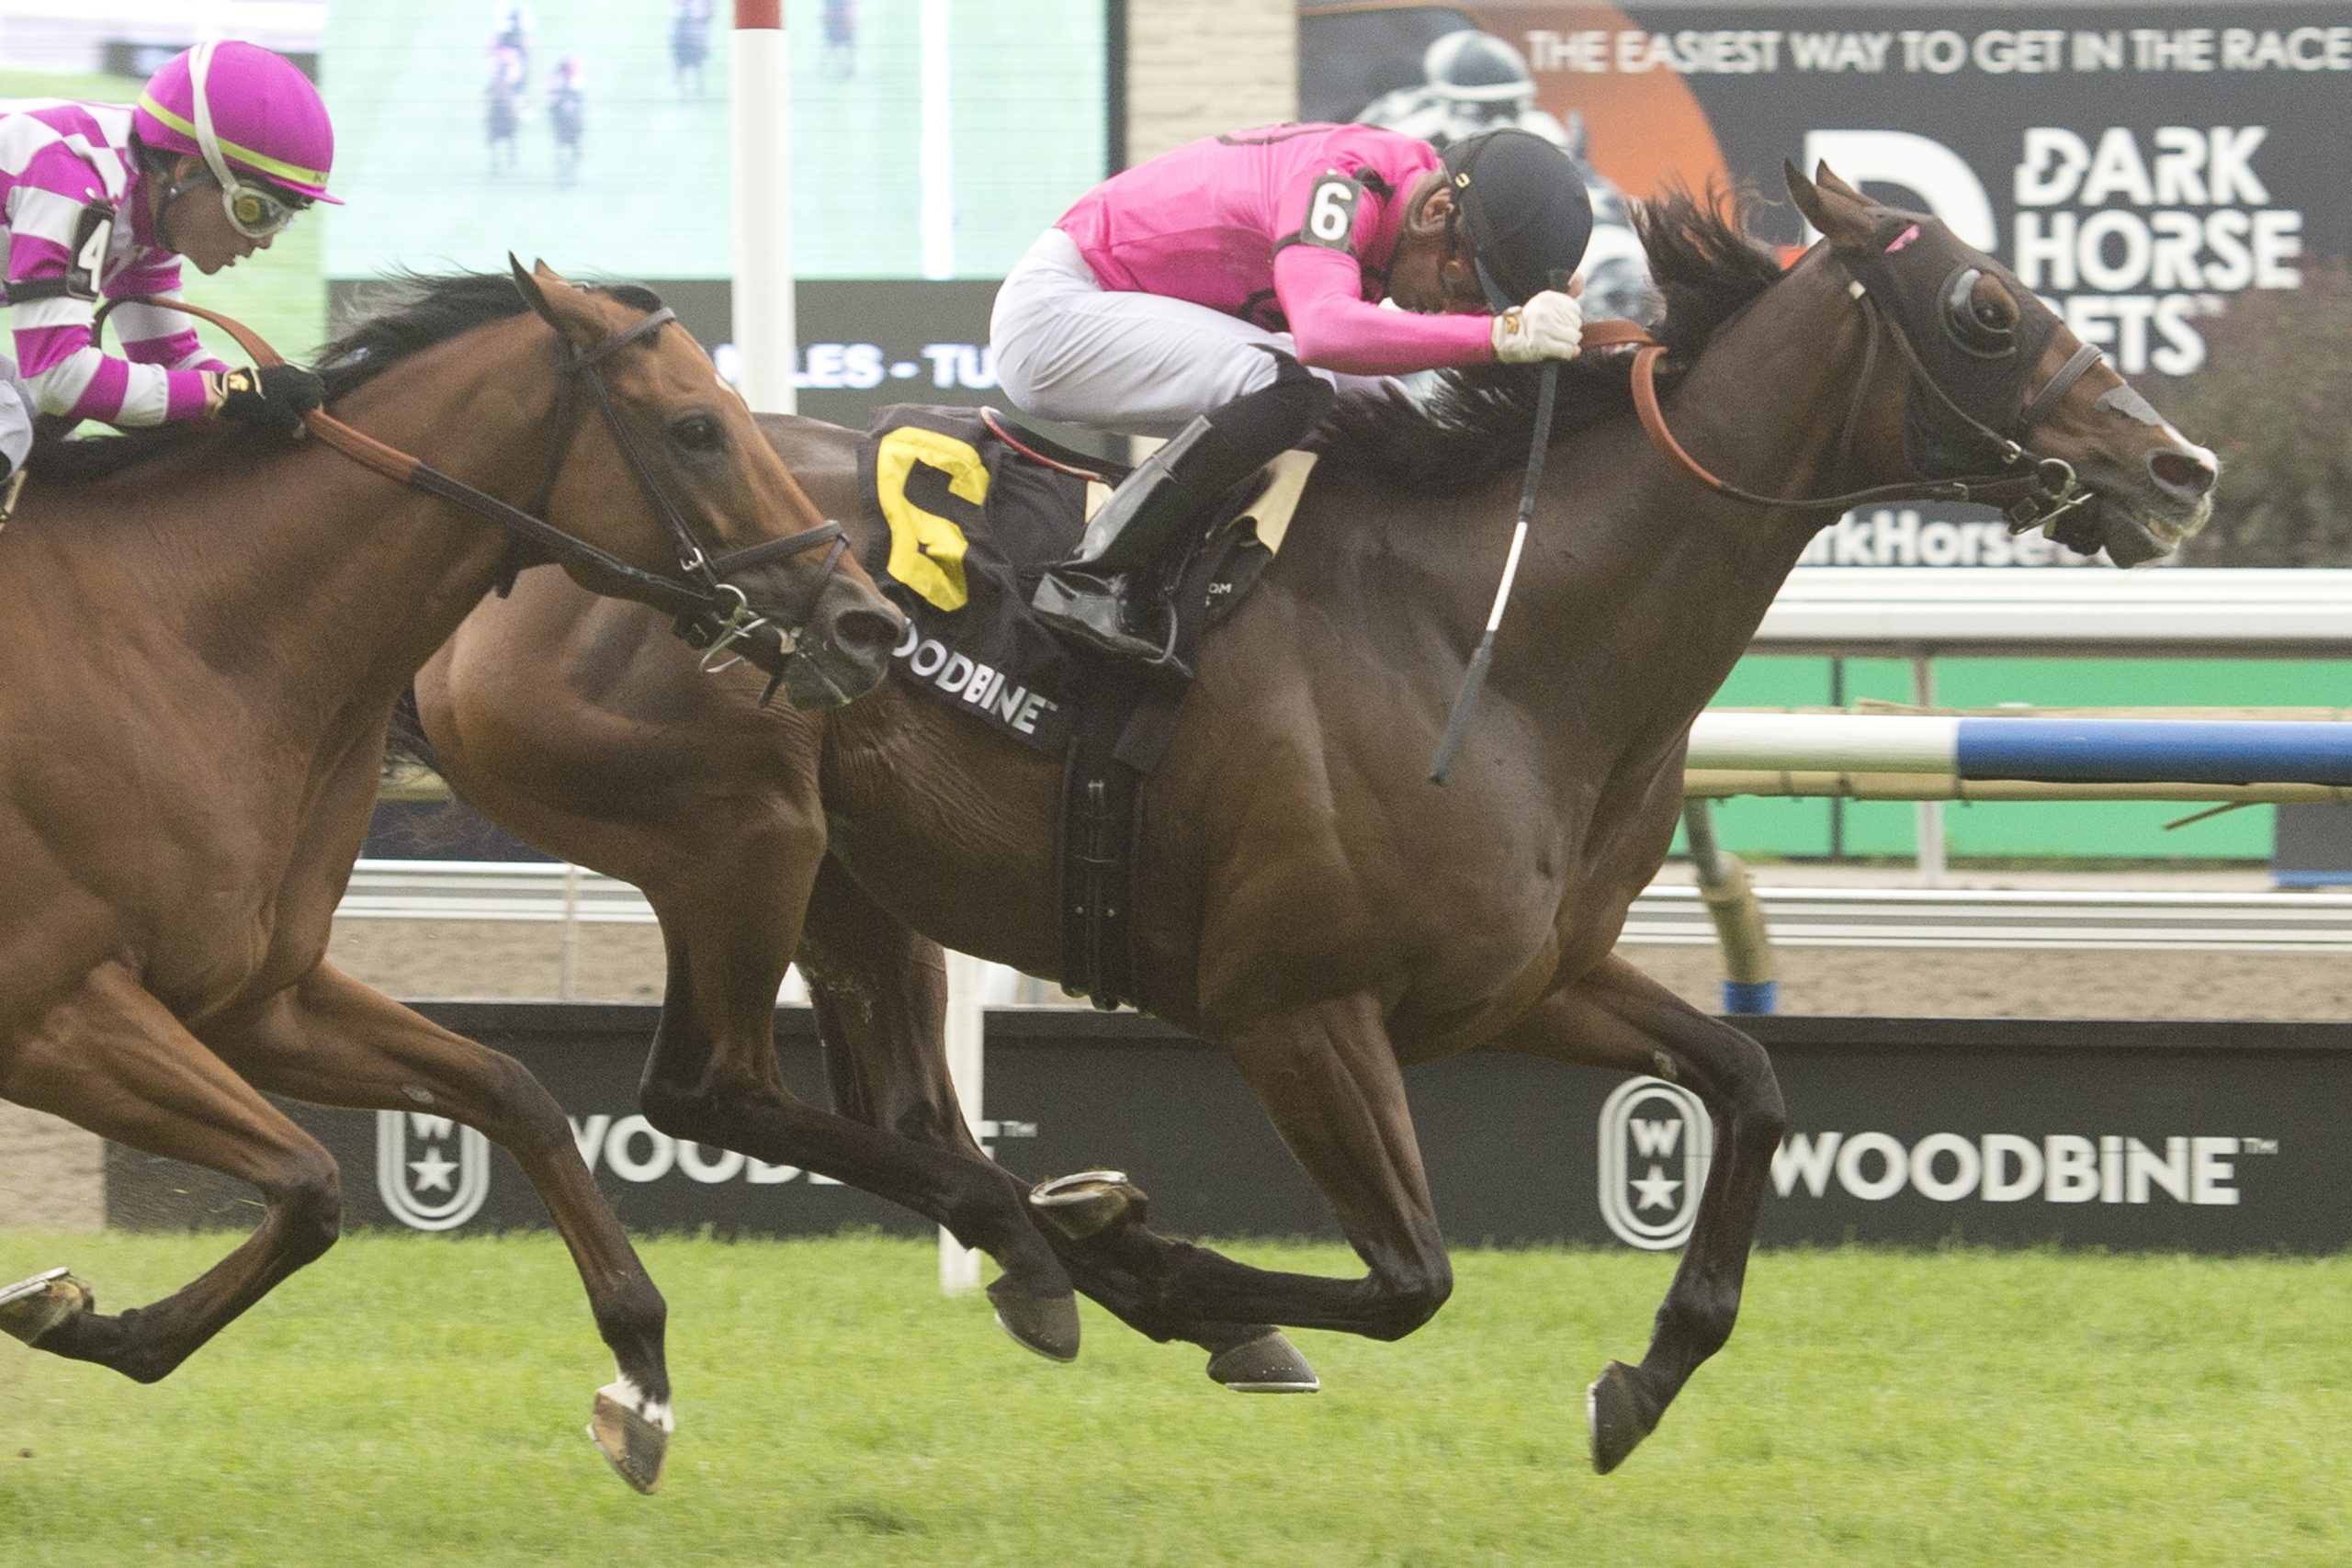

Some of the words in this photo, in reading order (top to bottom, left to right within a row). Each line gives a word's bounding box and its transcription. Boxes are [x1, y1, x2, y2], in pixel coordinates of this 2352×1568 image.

[1526, 29, 1609, 73] THE
[1615, 29, 1782, 74] EASIEST
[1788, 29, 1894, 73] WAY
[1898, 29, 1968, 74] TO
[1973, 28, 2066, 74] GET
[2072, 29, 2124, 73] IN
[2130, 28, 2215, 73] THE
[2222, 26, 2352, 72] RACE
[2015, 126, 2271, 207] DARK
[1310, 182, 1352, 242] 6
[2015, 209, 2303, 292] HORSE
[77, 219, 112, 293] 4
[2036, 293, 2206, 377] ETS
[876, 425, 990, 613] 6
[1629, 1118, 1683, 1158] W
